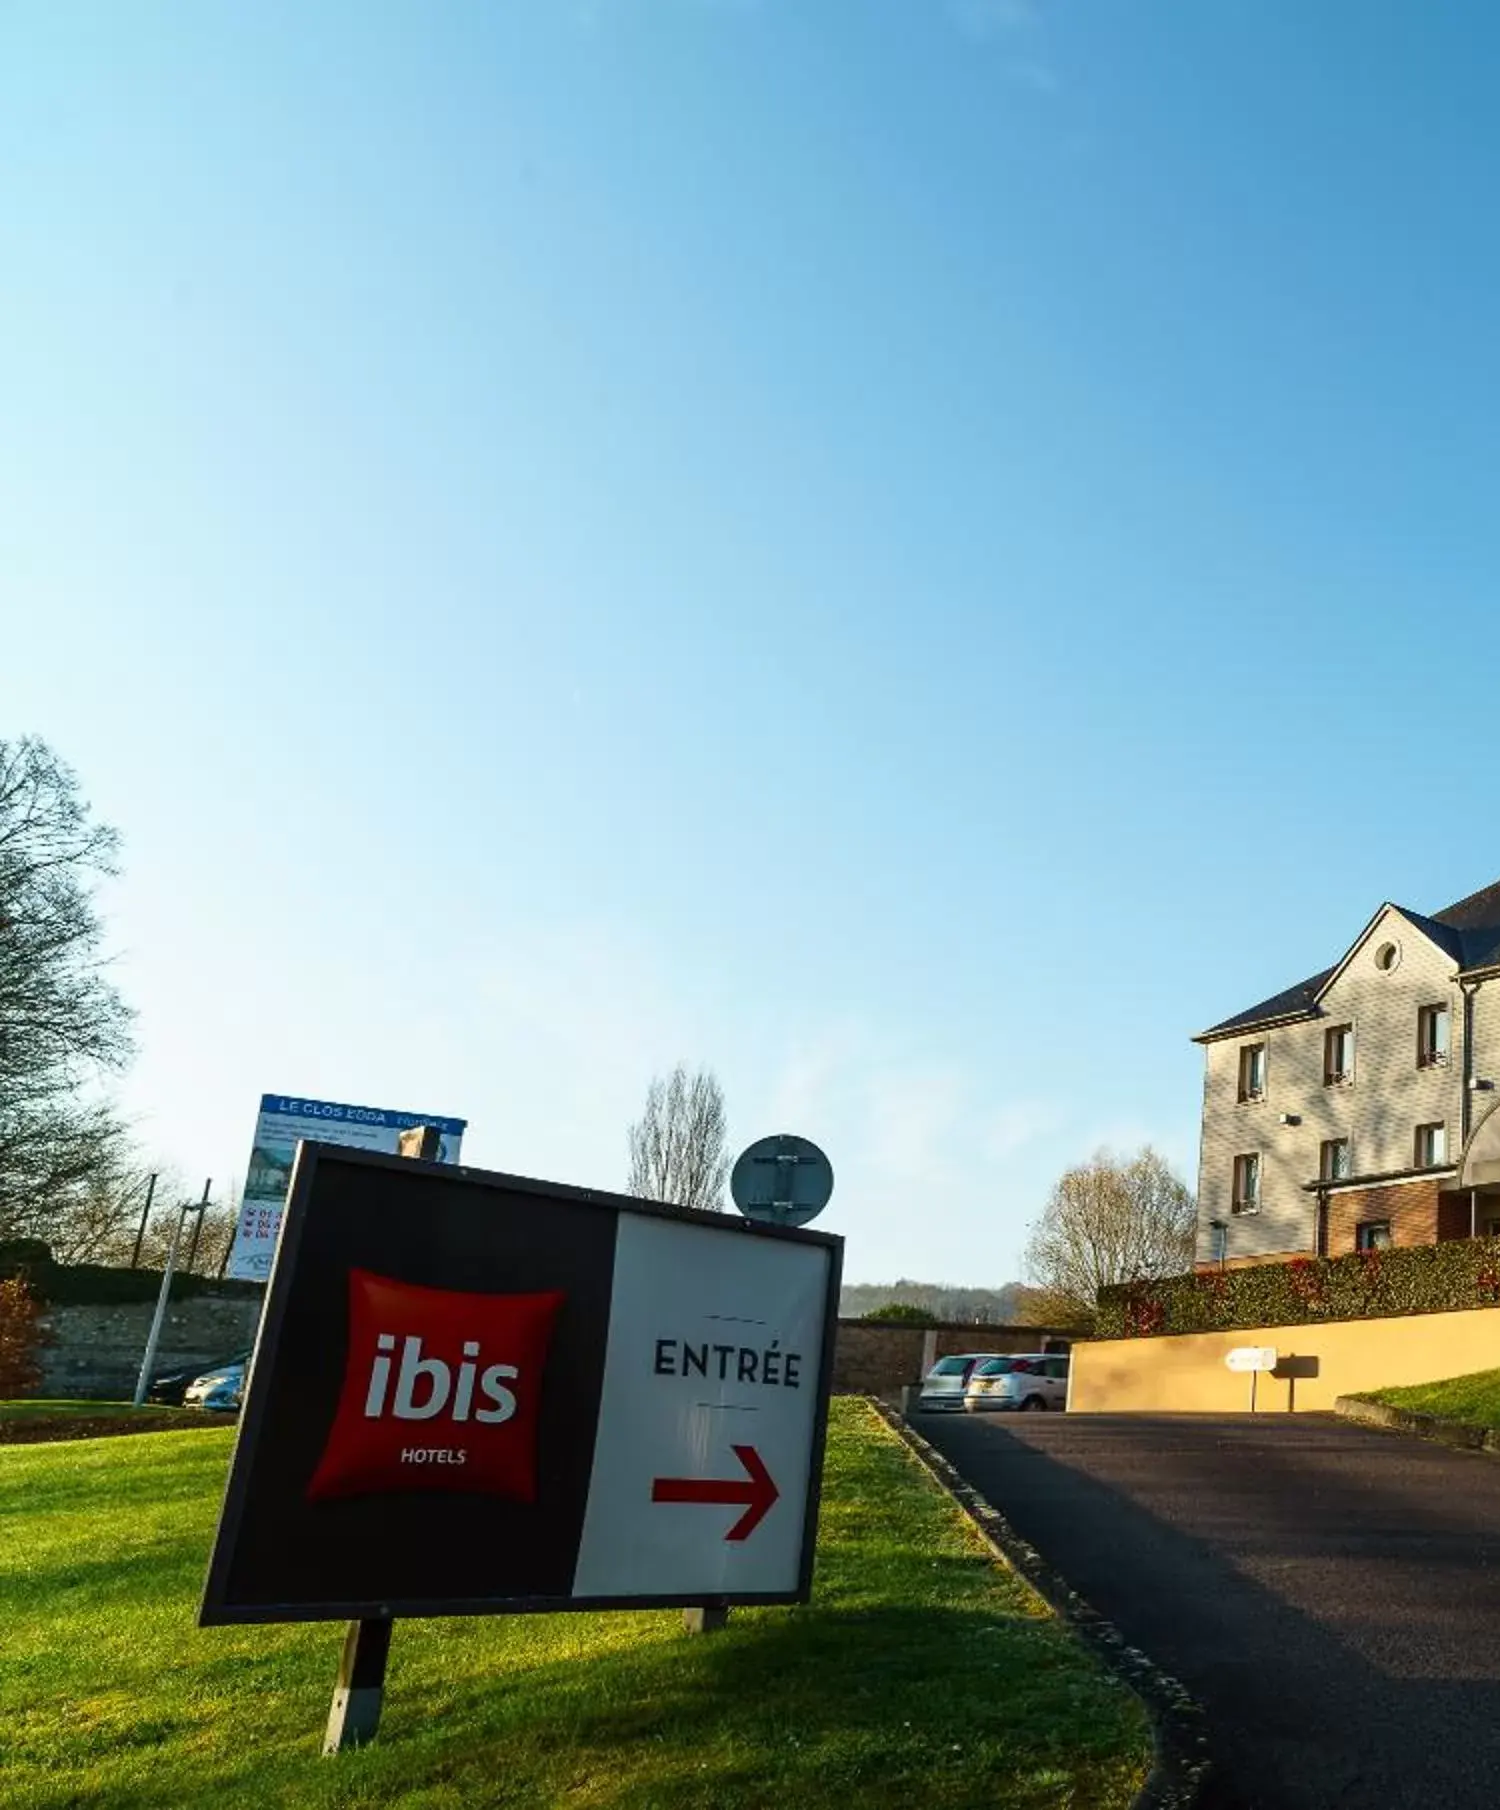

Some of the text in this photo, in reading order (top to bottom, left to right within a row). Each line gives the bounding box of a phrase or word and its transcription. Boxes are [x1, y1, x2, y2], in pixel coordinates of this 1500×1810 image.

[279, 1099, 299, 1113] LE
[303, 1103, 341, 1117] CLOS
[363, 1333, 519, 1425] ibis
[654, 1339, 802, 1389] ENTRÉE
[400, 1448, 467, 1466] HOTELS
